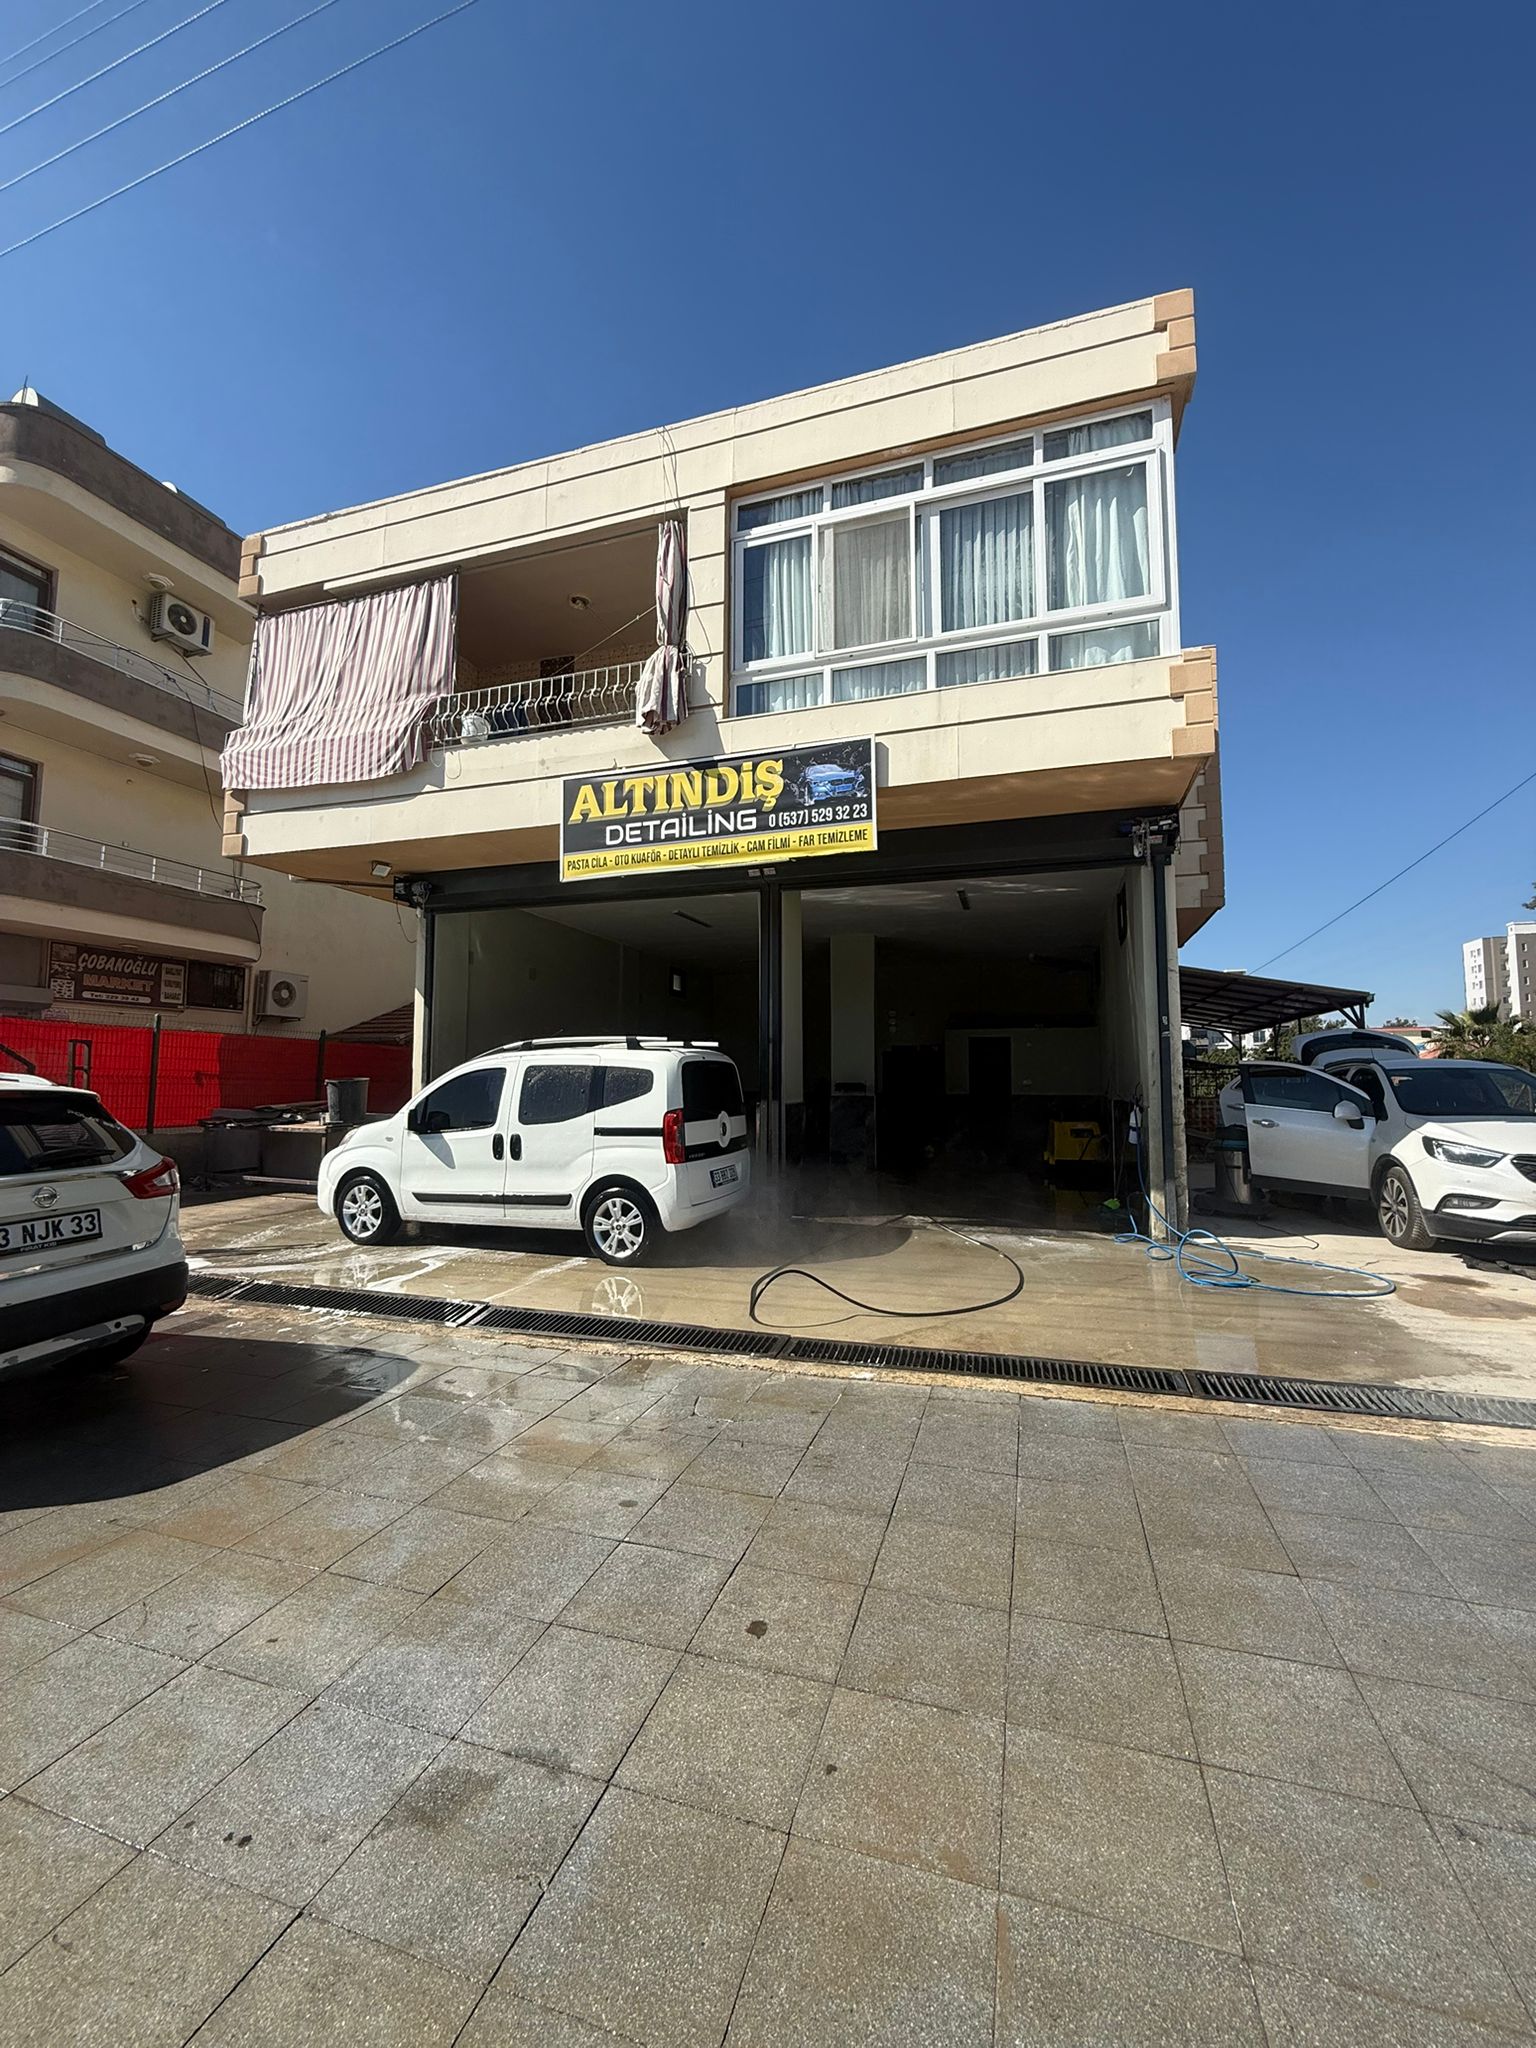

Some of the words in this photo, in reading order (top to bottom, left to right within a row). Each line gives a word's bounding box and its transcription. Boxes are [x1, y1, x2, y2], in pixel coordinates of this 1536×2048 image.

[567, 759, 784, 824] ALTINDİŞ
[605, 809, 757, 845] DETAİLİNG
[769, 813, 776, 827] 0
[779, 810, 808, 827] (537)
[811, 807, 833, 823] 529
[836, 804, 850, 820] 32
[853, 803, 868, 818] 23
[567, 859, 590, 871] PASTA
[591, 855, 608, 869] CİLA
[614, 855, 630, 866] OTO
[631, 849, 662, 864] KUAFÖR
[668, 847, 700, 860] DETAYLI
[702, 842, 740, 857] TEMİZLİK
[747, 839, 765, 853] CAM
[767, 834, 790, 850] FİLMİ
[798, 833, 815, 847] FAR
[817, 829, 868, 844] TEMİZLEME
[78, 953, 159, 977] ÇOBANOĞLU
[83, 973, 154, 992] MARKET
[22, 1219, 64, 1244] NJK
[70, 1213, 97, 1235] 33
